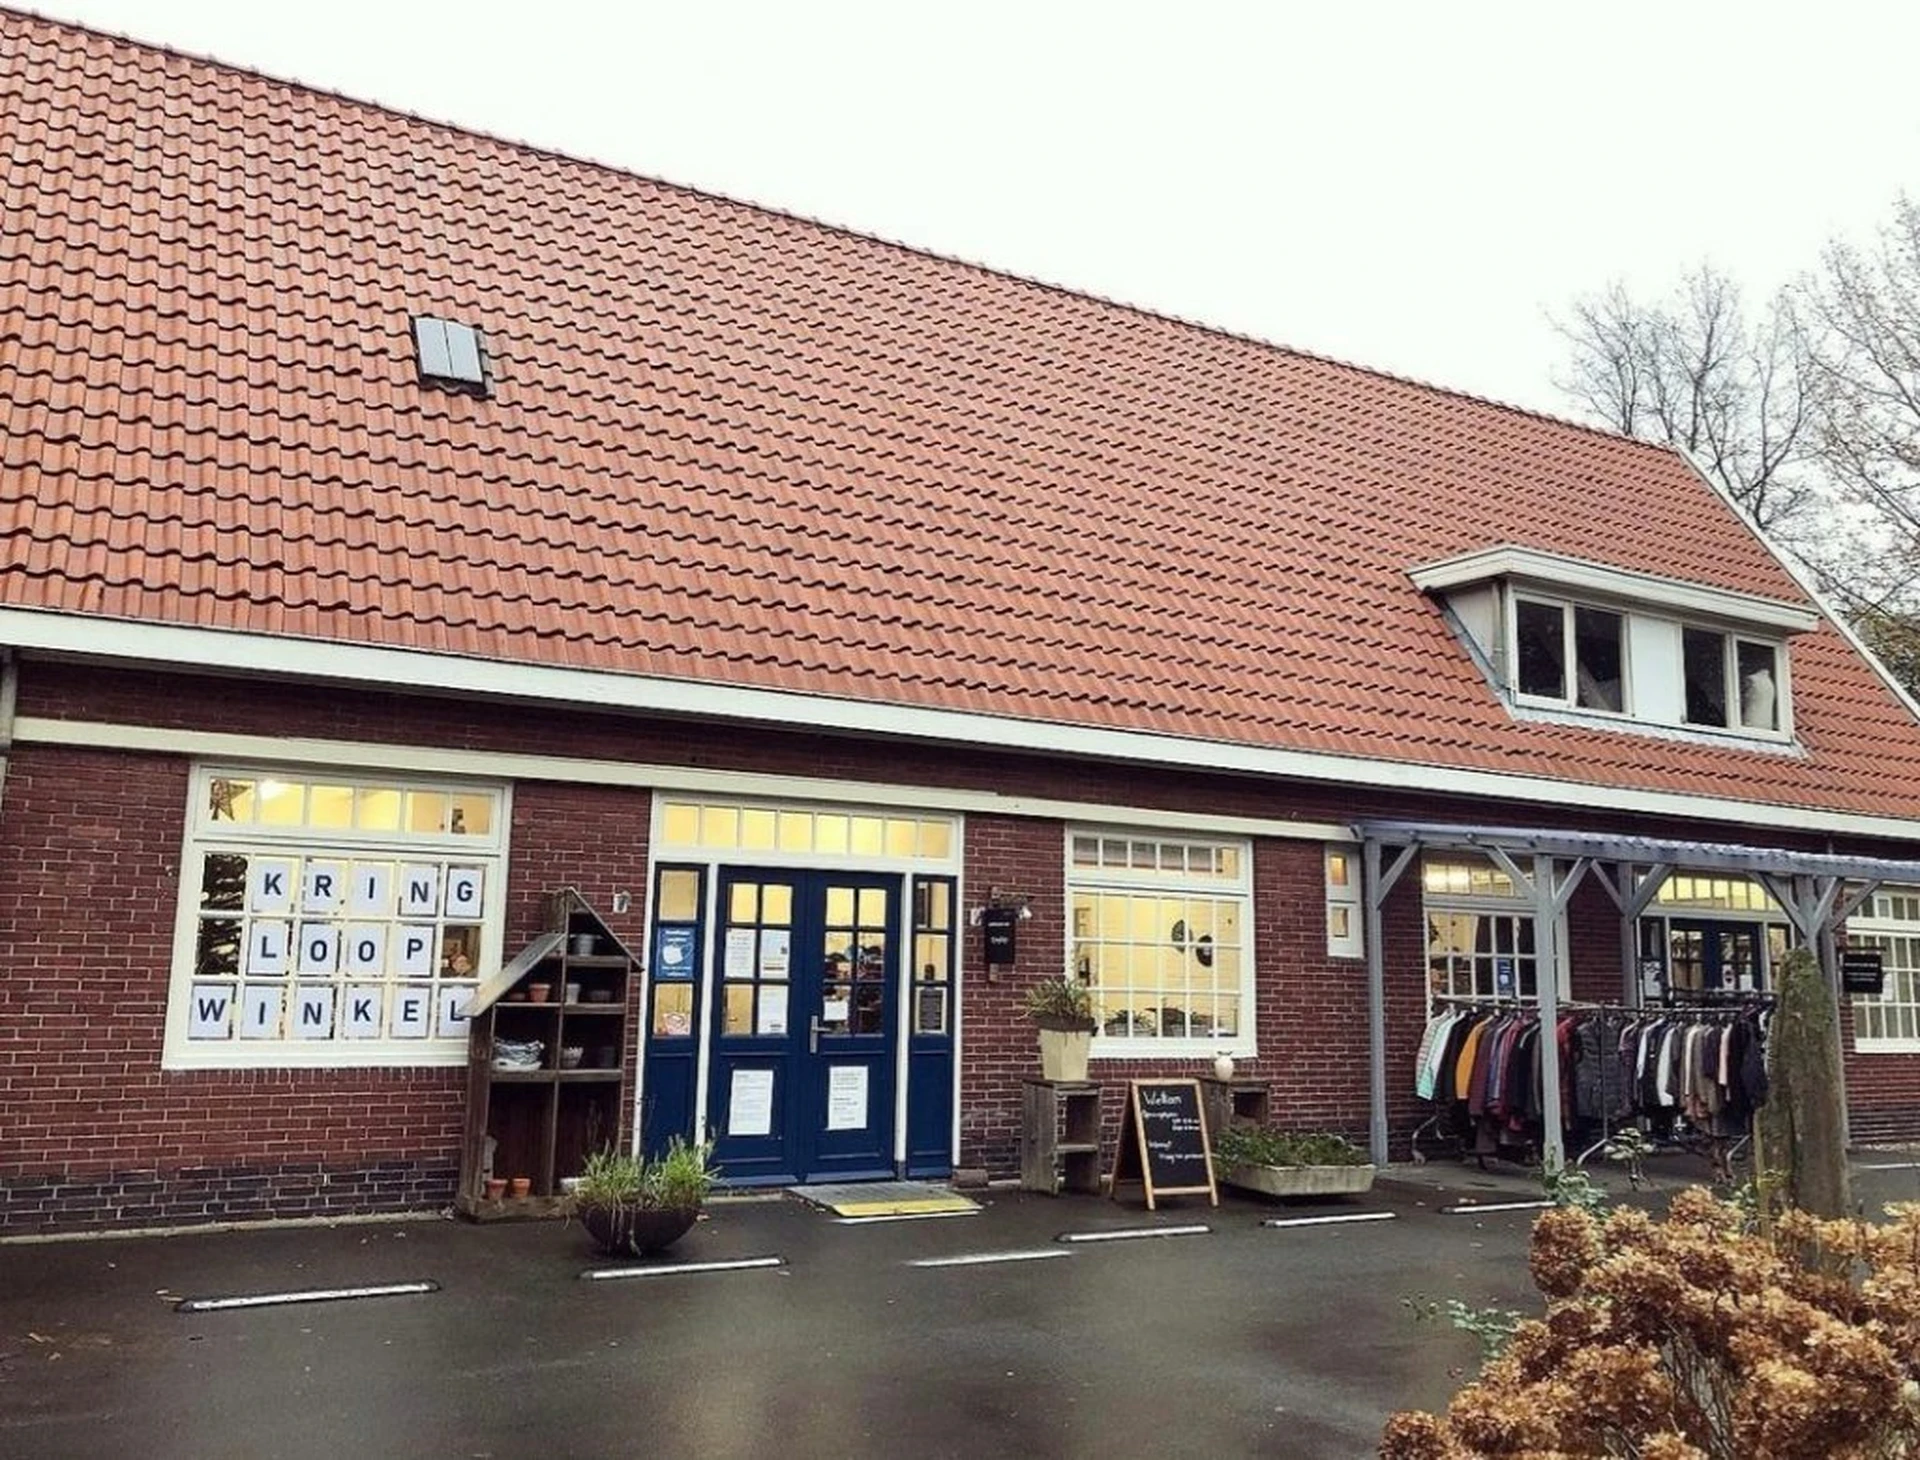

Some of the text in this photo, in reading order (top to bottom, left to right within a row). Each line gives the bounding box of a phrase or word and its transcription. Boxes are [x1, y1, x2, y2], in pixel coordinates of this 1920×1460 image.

[263, 872, 474, 903] KRING
[260, 936, 424, 963] LOOP
[199, 998, 464, 1026] WINKEL
